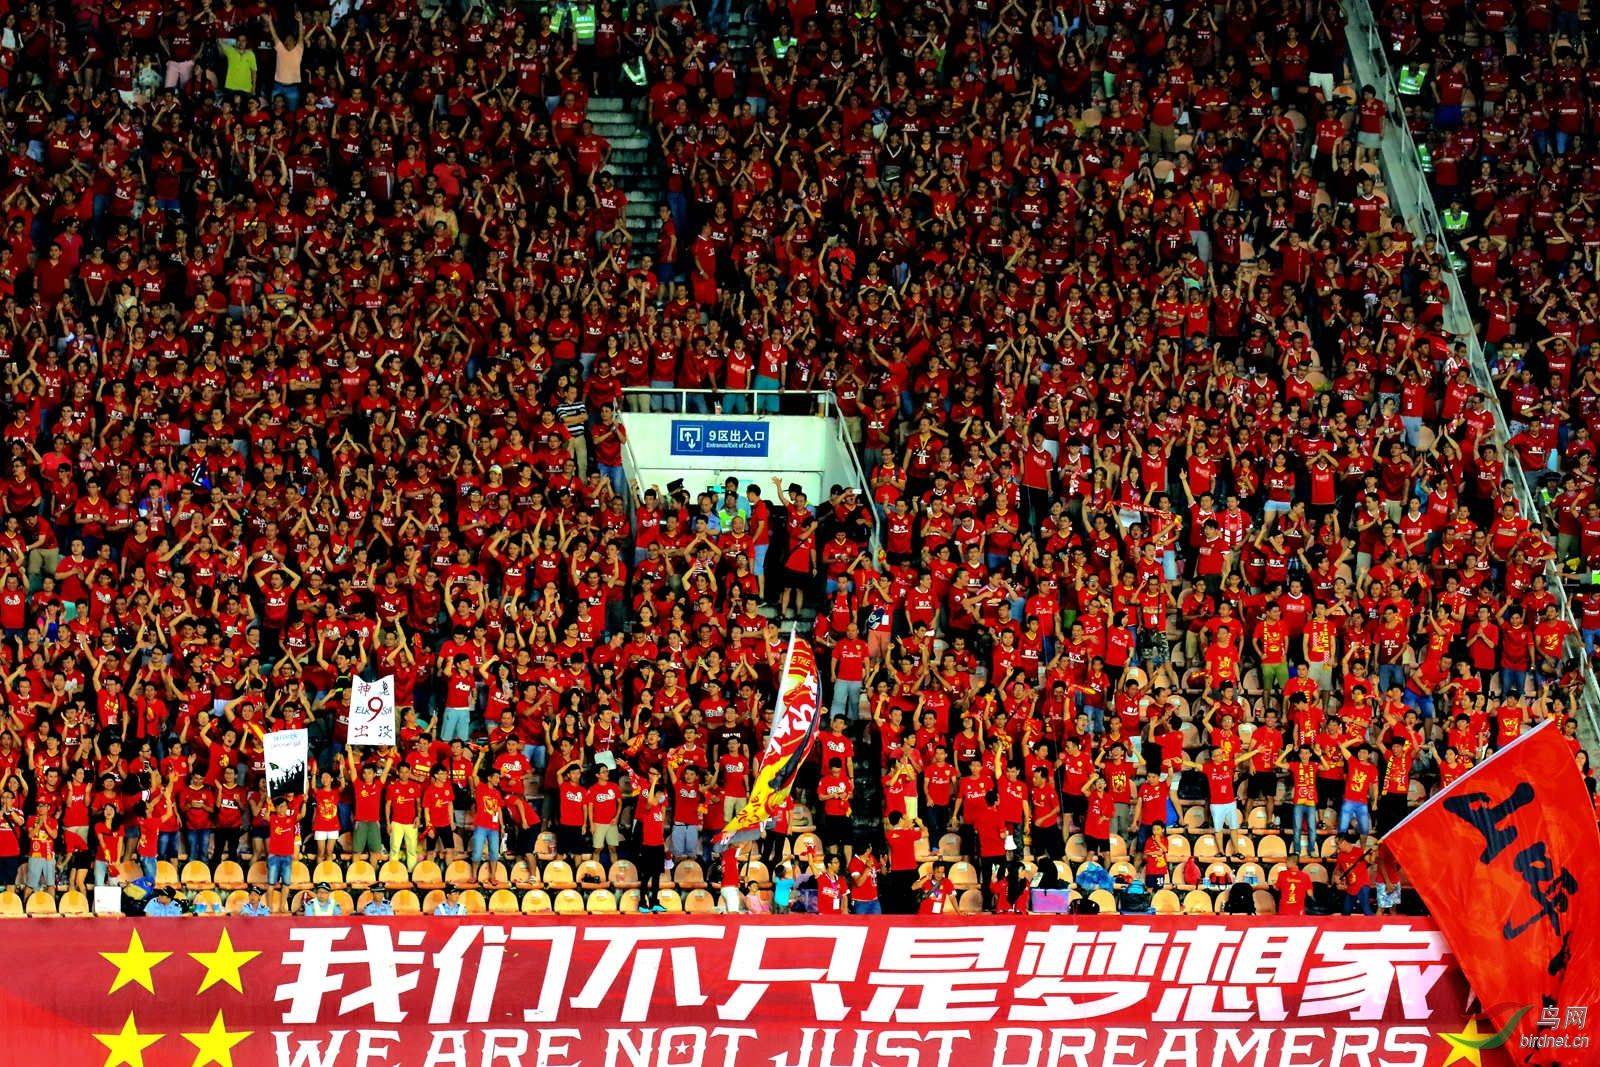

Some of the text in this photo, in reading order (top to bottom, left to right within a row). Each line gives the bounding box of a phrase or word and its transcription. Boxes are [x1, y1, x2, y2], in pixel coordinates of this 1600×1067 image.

[708, 429, 765, 442] 9区出入口
[273, 924, 1453, 1024] 我们不只是梦想家
[271, 1027, 1429, 1067] WE ARE NOT JUST DREAMERS
